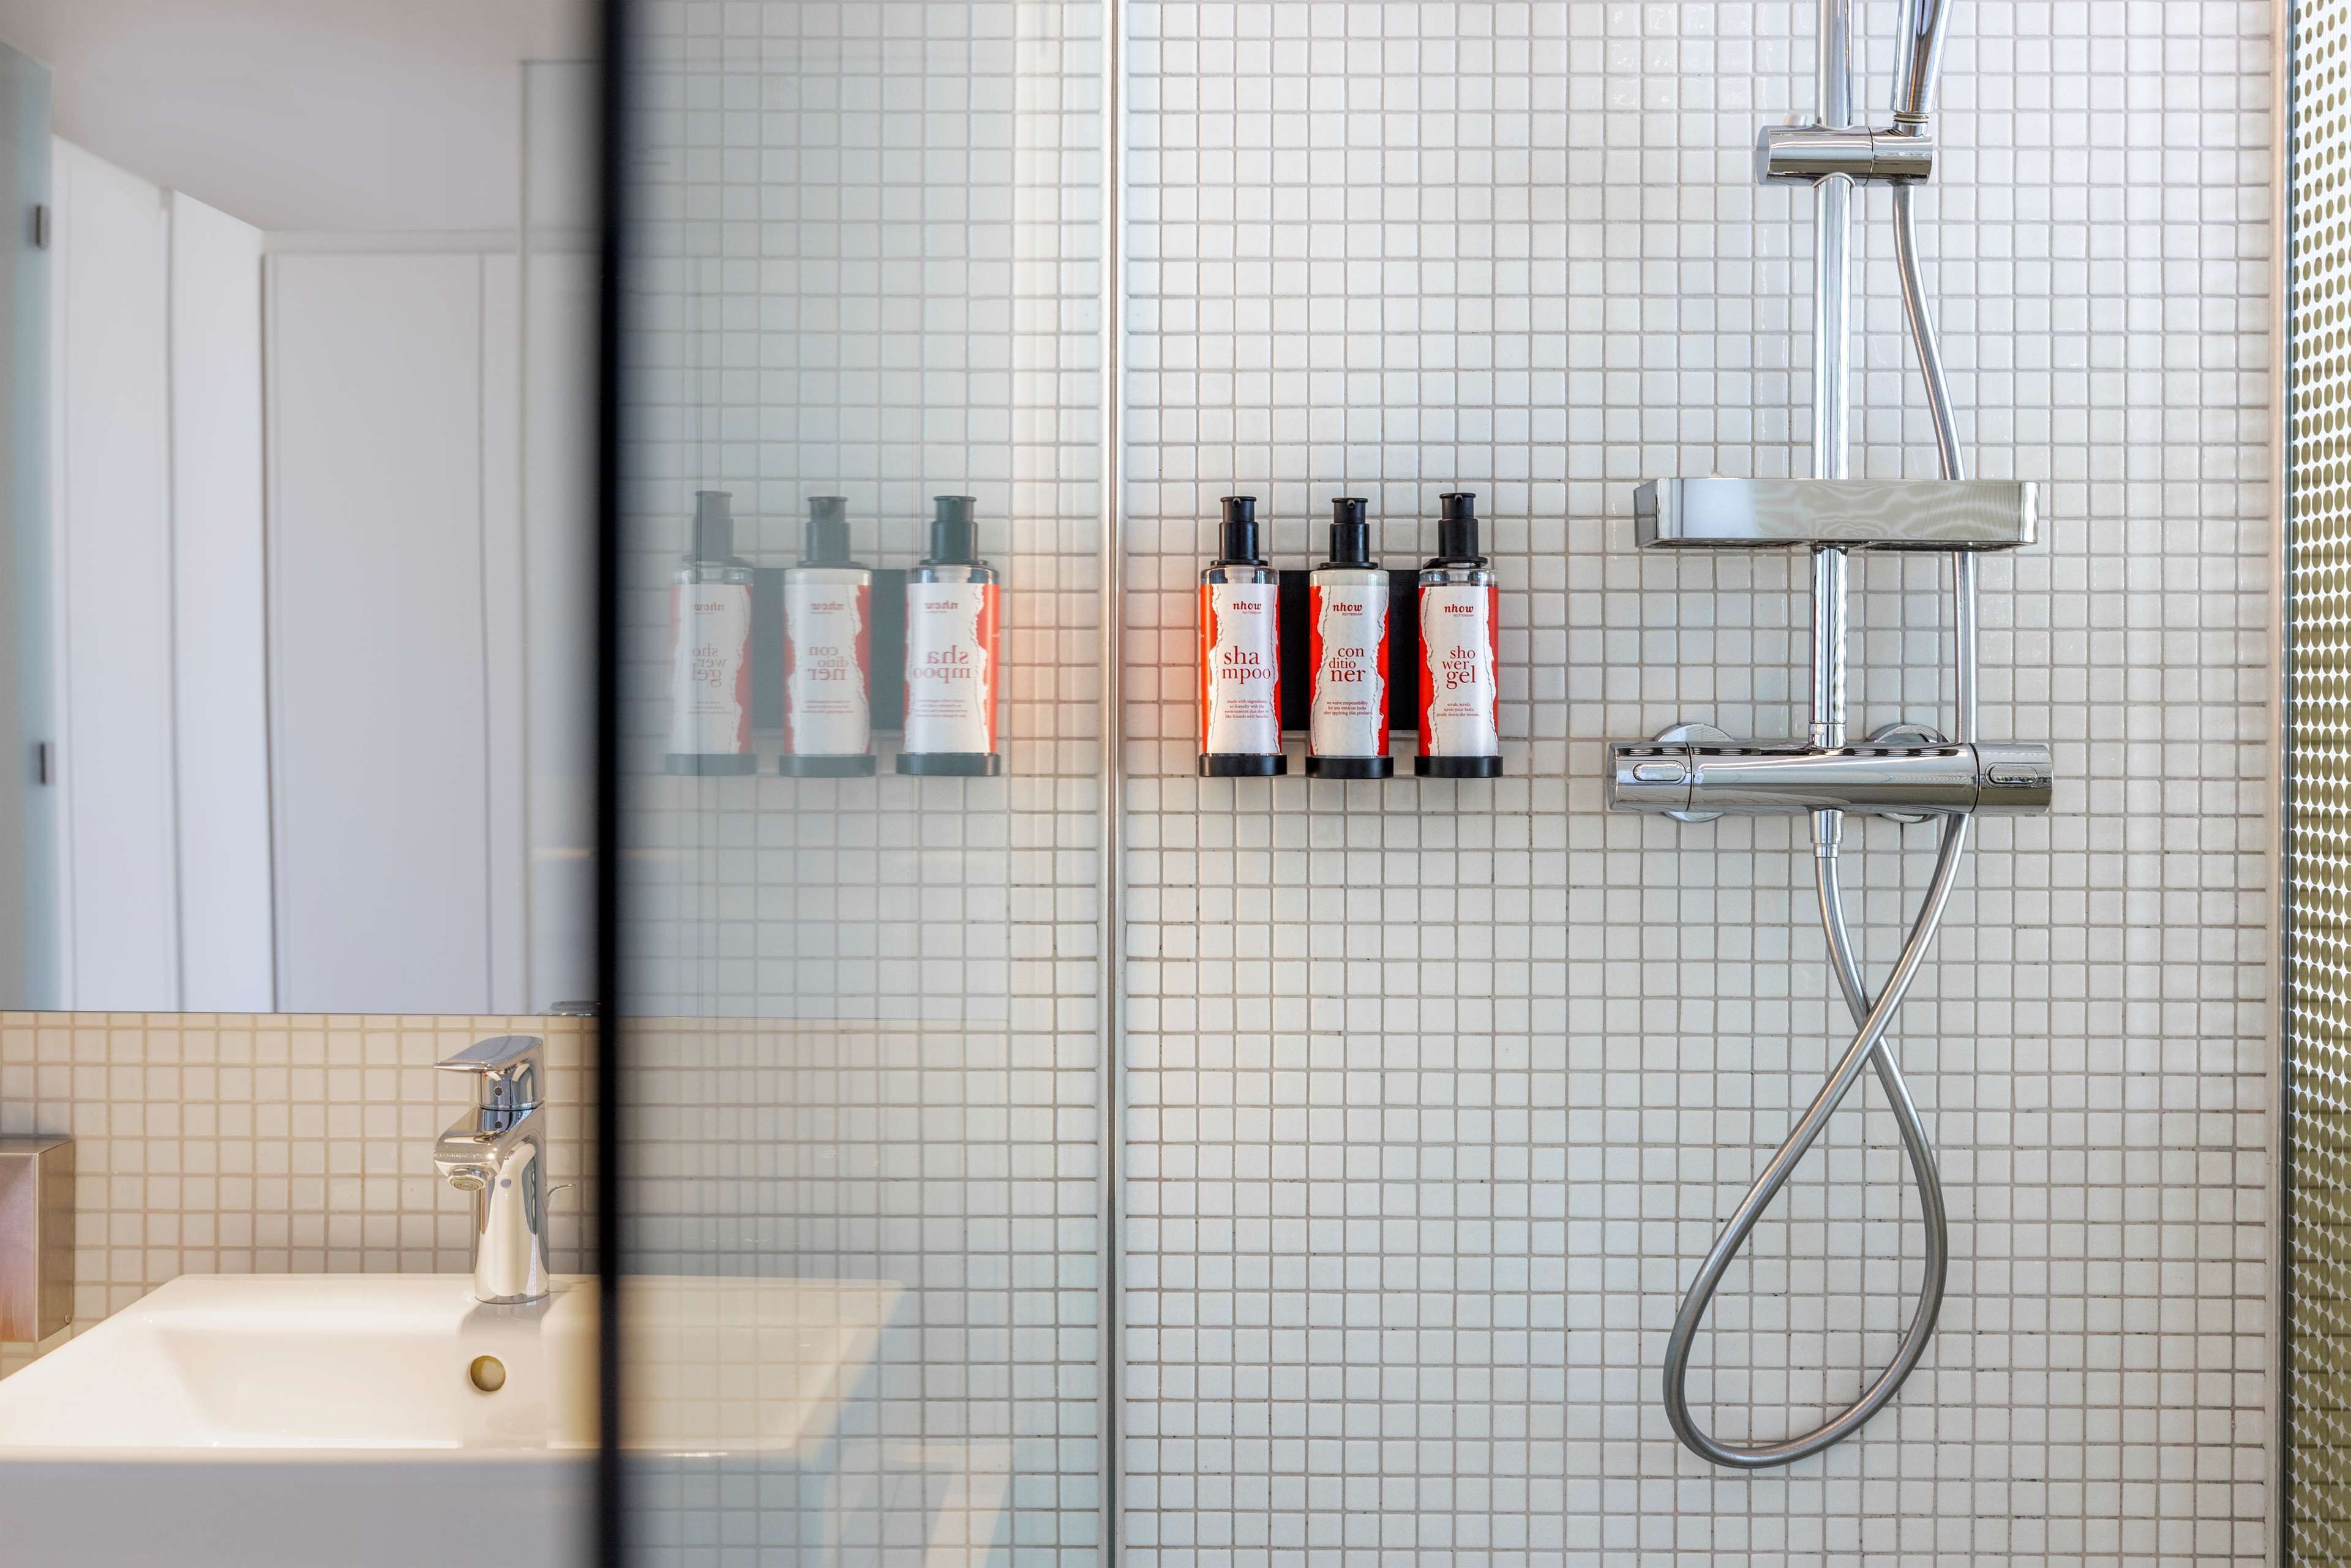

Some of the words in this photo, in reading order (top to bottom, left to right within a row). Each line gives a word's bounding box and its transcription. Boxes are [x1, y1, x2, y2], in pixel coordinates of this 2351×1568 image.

[1233, 601, 1262, 610] nhow
[1333, 602, 1362, 612] nhow
[1444, 604, 1474, 613] nhow
[1224, 645, 1260, 665] sha
[1338, 648, 1365, 657] con
[1450, 645, 1475, 659] sho
[1329, 657, 1356, 669] ditio
[1442, 661, 1469, 670] wer
[1222, 668, 1271, 685] mpoo
[1331, 670, 1366, 682] ner
[1446, 665, 1476, 689] gel
